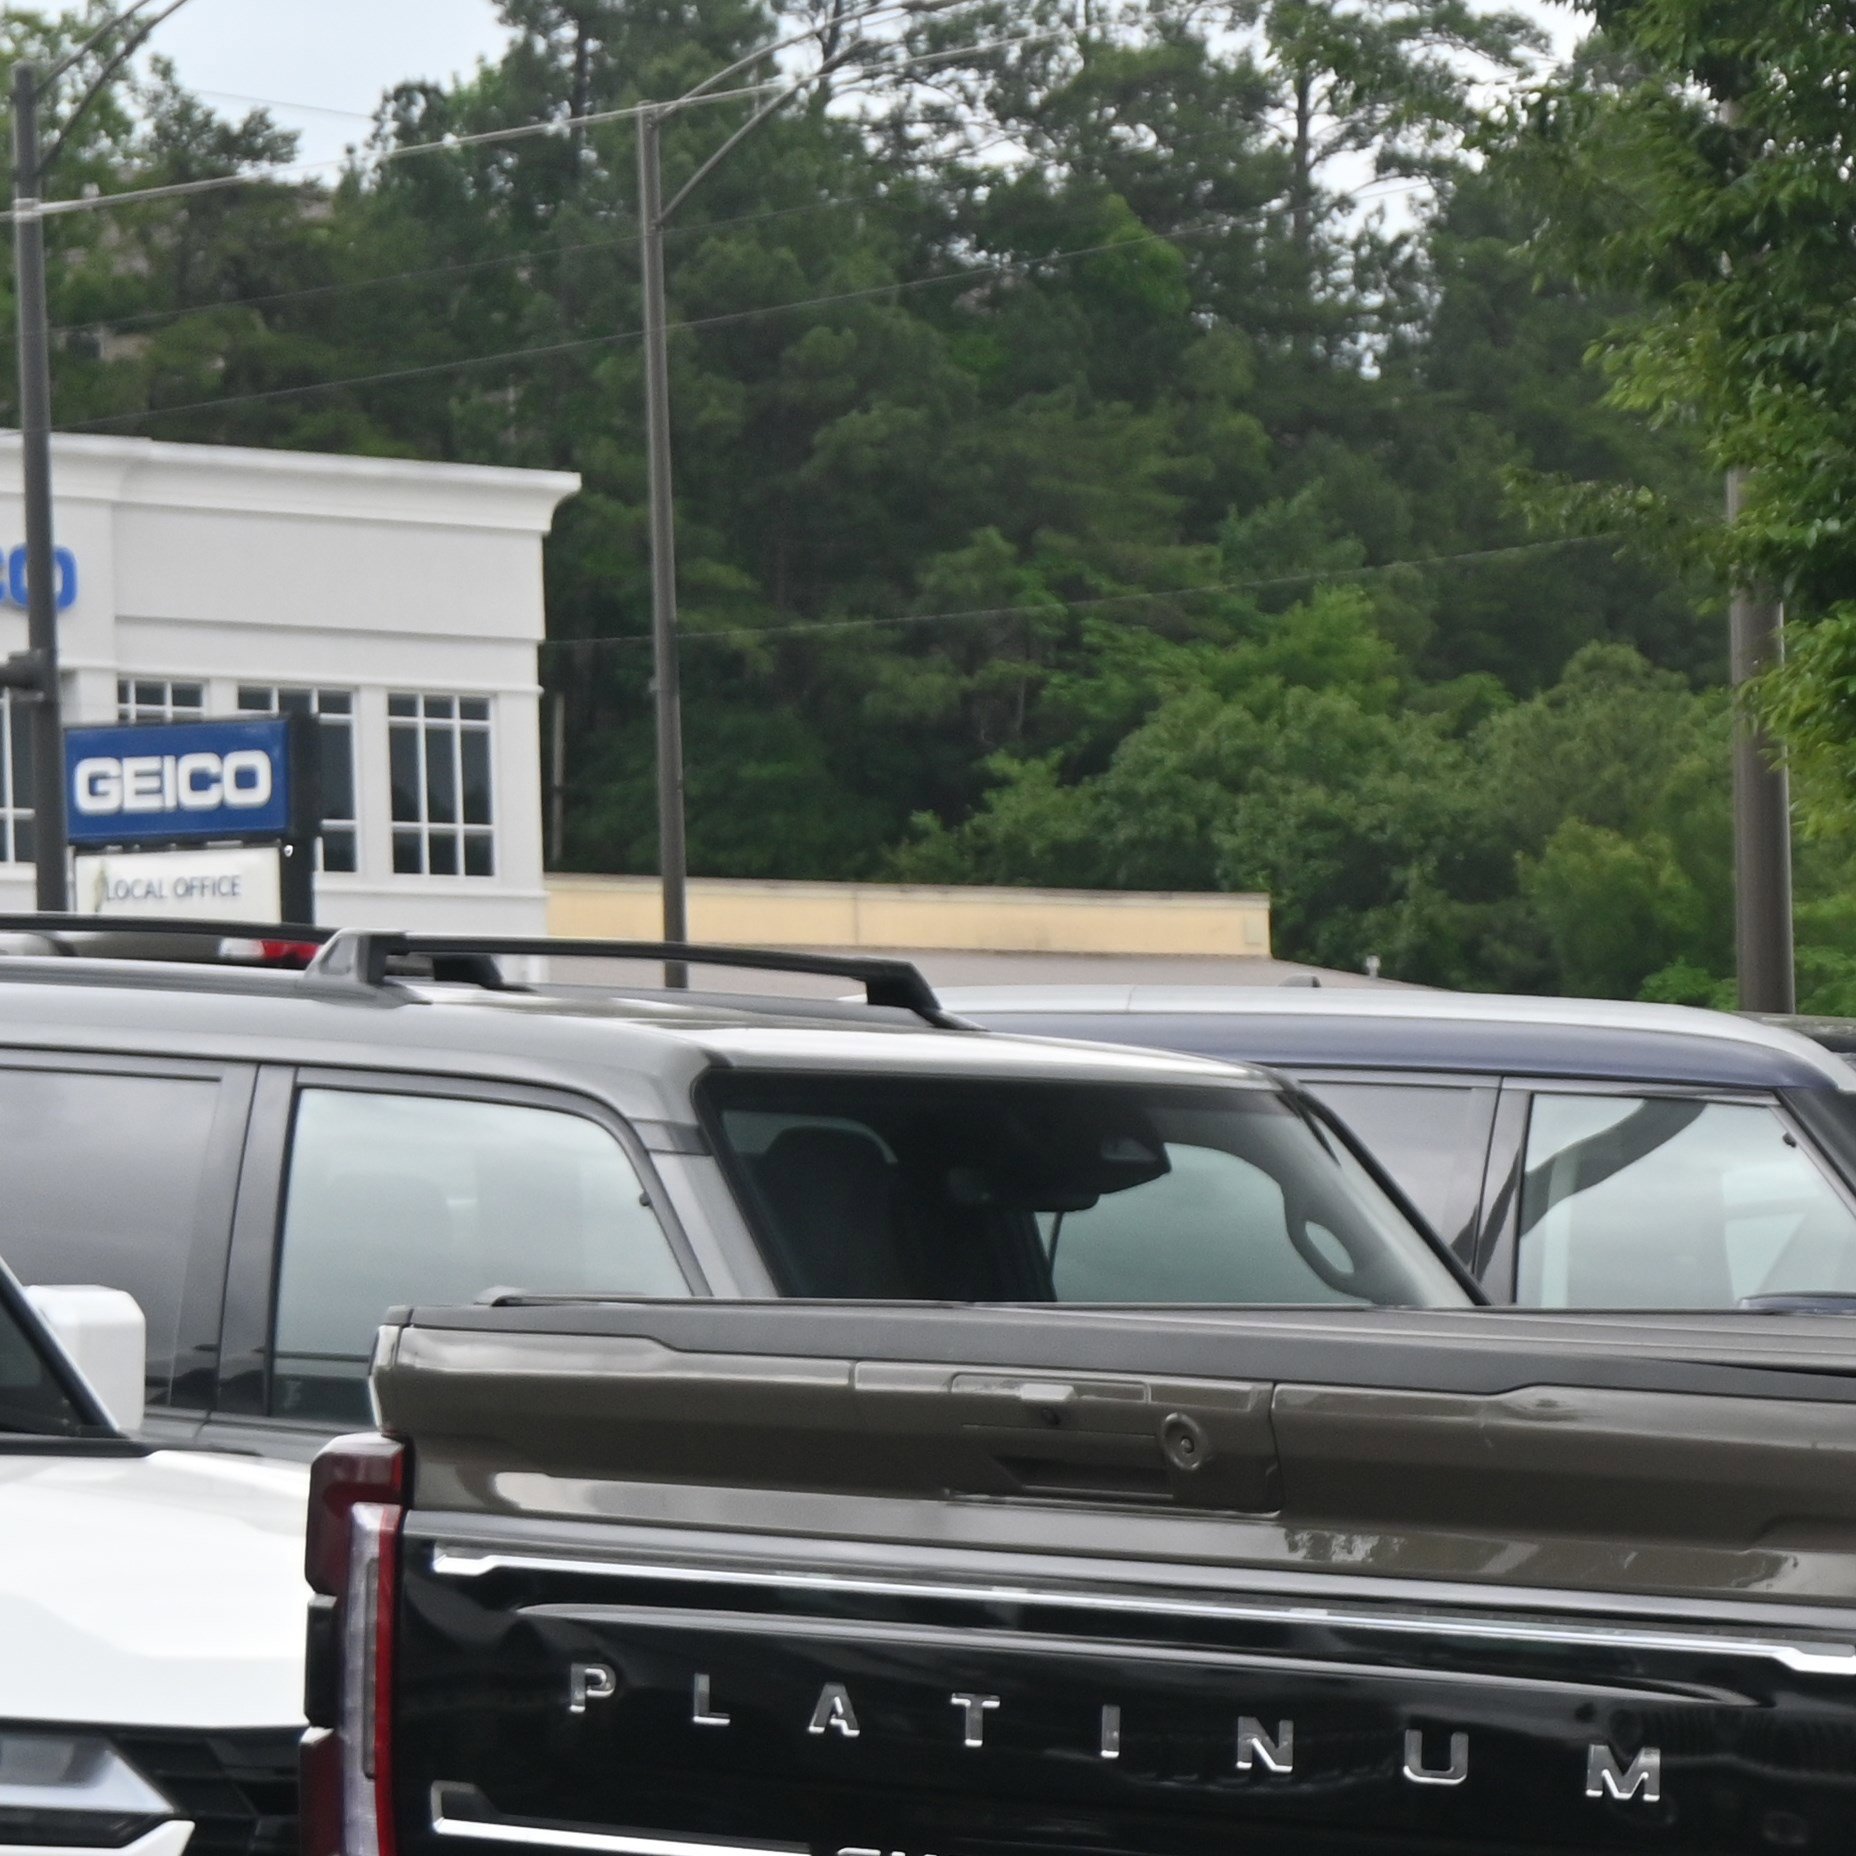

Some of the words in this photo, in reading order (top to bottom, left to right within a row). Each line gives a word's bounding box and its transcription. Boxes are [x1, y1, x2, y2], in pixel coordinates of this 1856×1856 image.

[75, 750, 272, 815] GEICO
[106, 877, 166, 902] LOCAL
[173, 875, 242, 898] OFFICE
[570, 1662, 1661, 1801] PLATINUM
